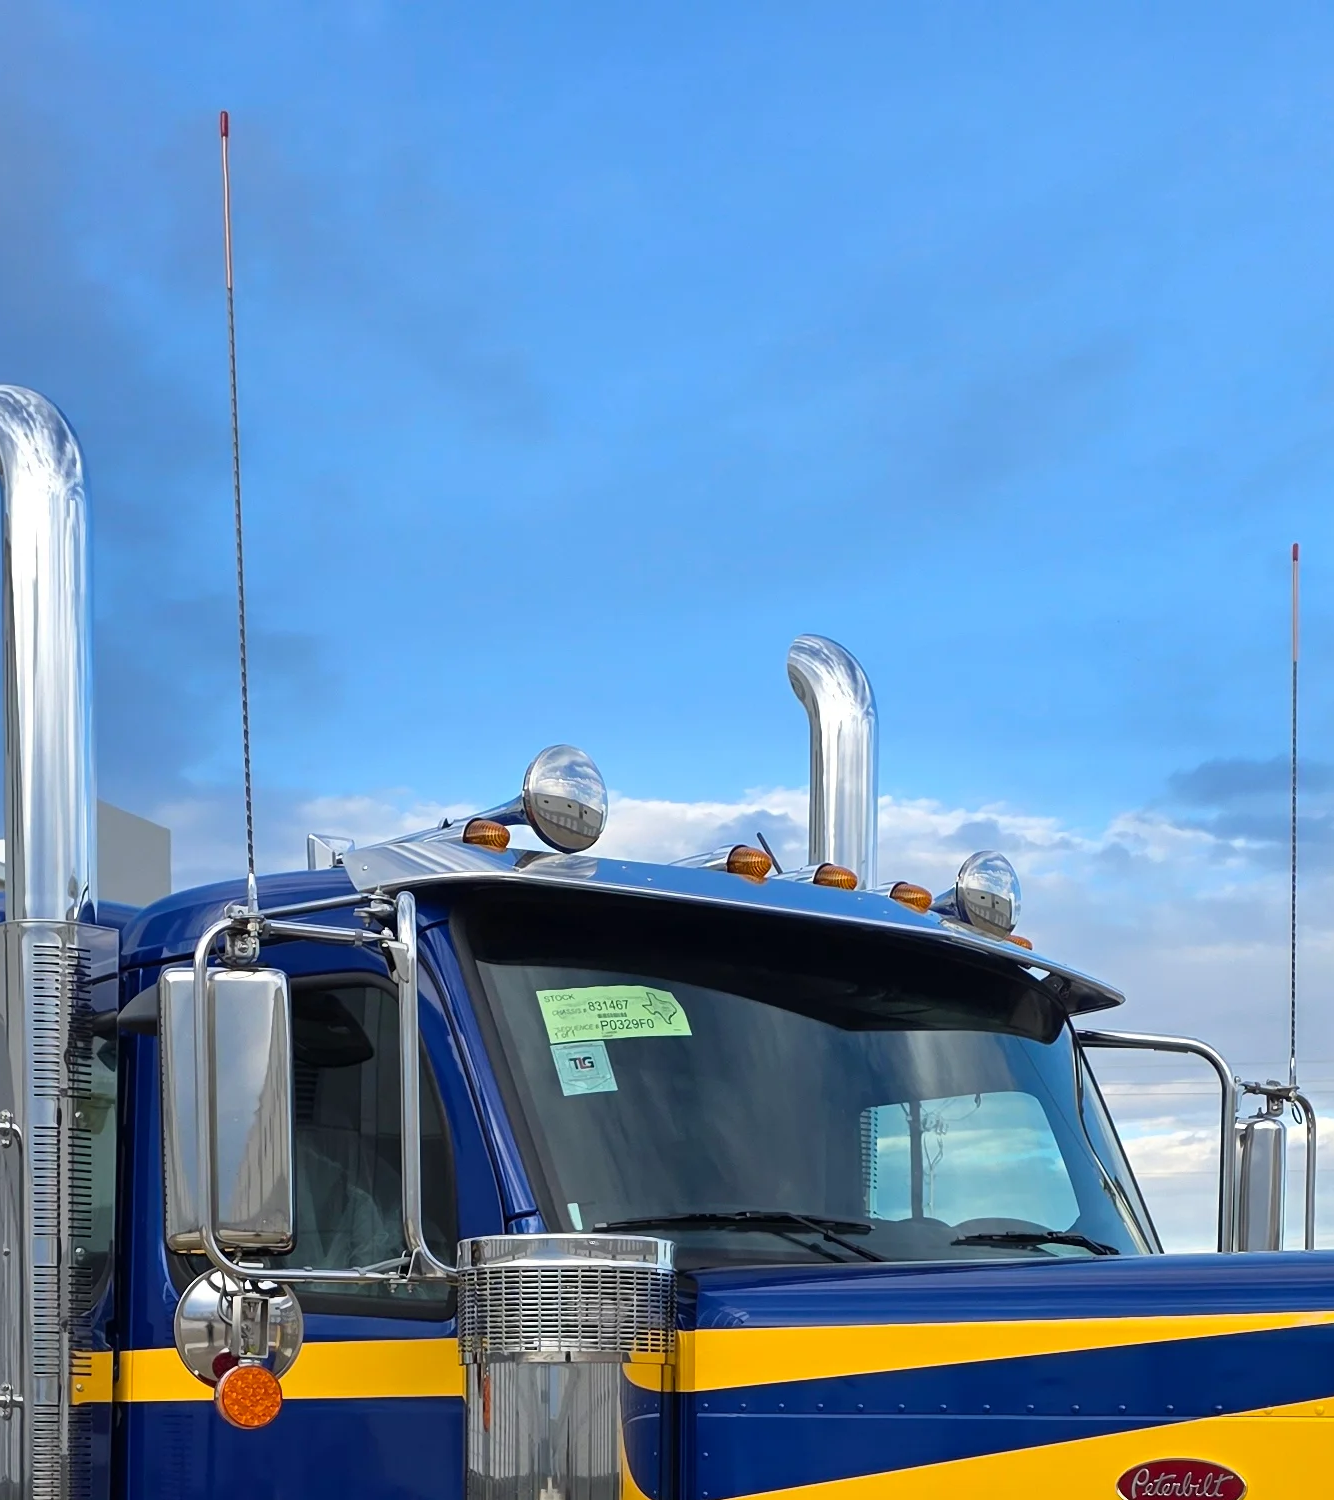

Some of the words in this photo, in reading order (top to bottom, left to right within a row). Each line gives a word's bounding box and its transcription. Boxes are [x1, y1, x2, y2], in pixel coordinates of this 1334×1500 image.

[543, 994, 575, 1003] STOCK
[552, 1007, 582, 1016] CHASSIS
[587, 999, 629, 1012] 831467
[600, 1018, 655, 1032] P0329F0
[568, 1056, 595, 1070] TLG
[1130, 1467, 1235, 1500] Peterbilt
